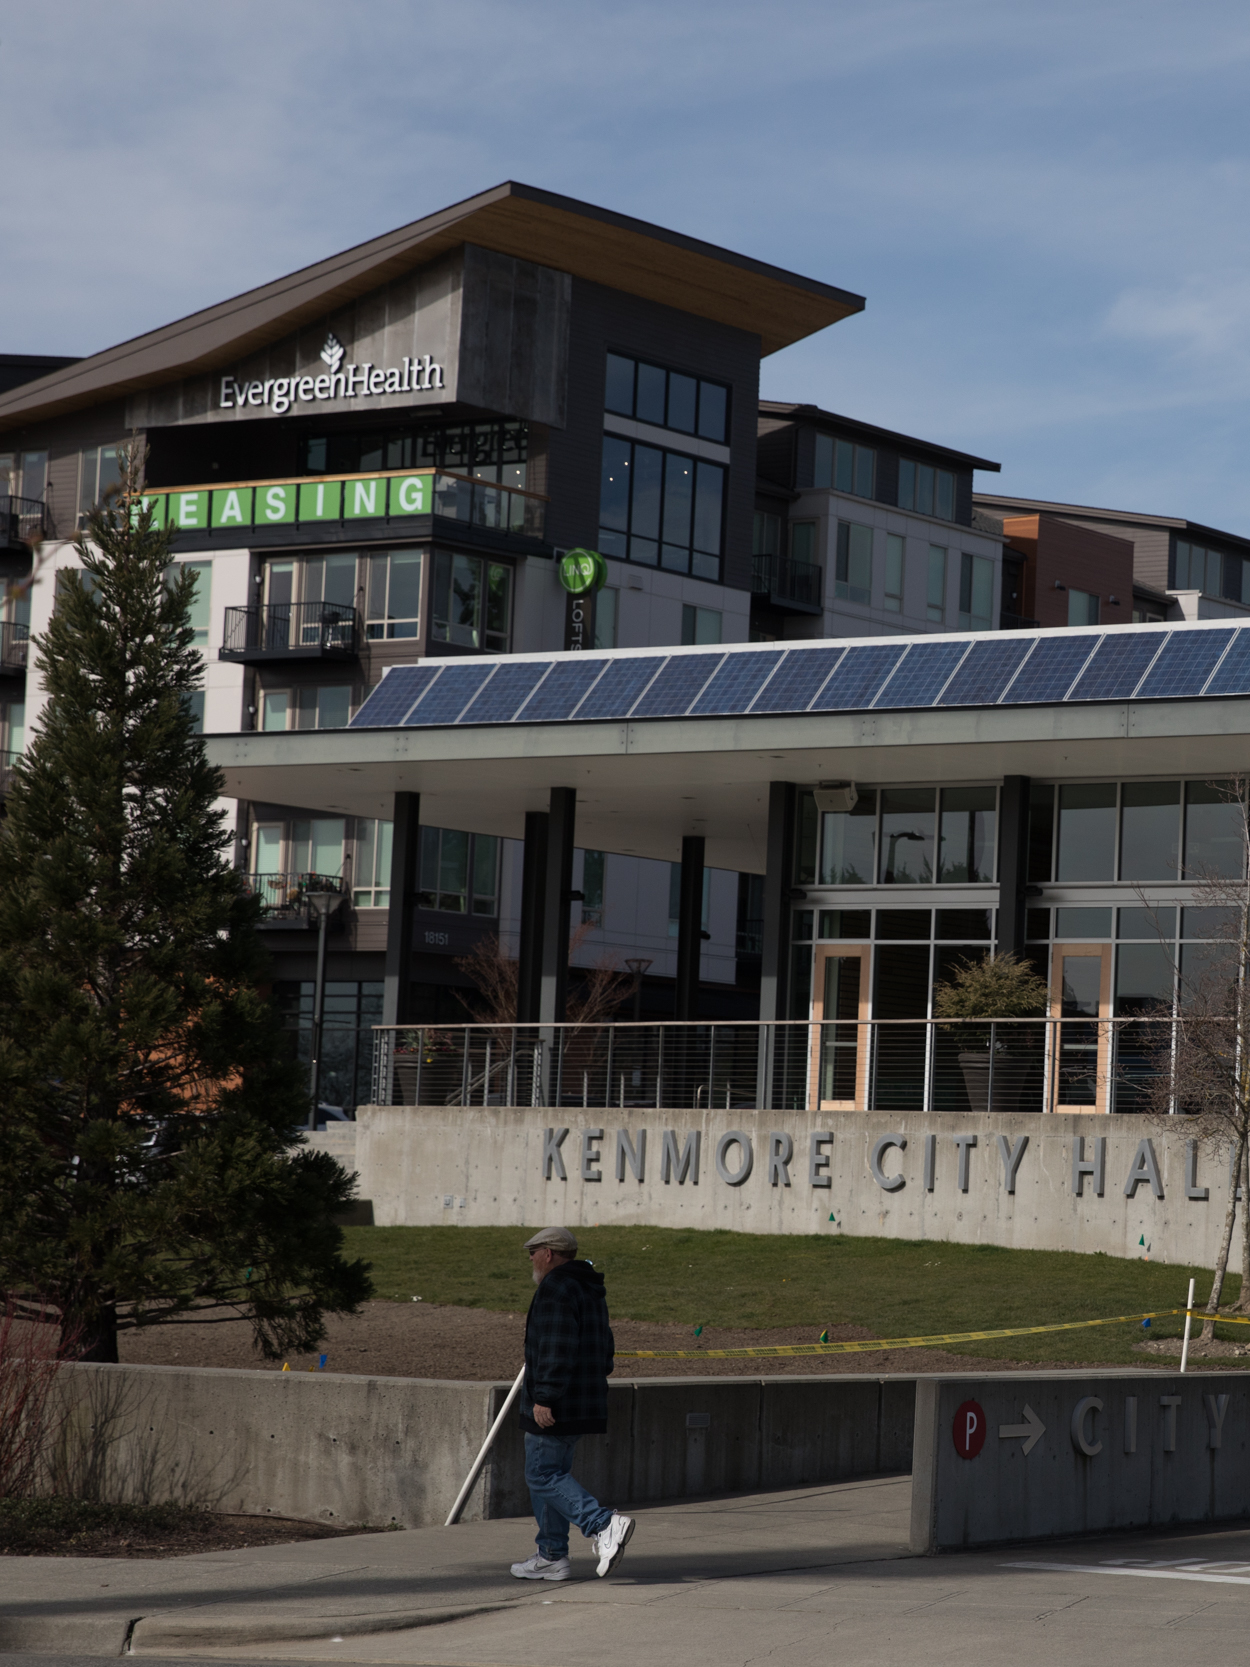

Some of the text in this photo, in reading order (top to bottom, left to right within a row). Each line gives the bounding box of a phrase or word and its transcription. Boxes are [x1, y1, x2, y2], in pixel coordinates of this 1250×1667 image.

[220, 355, 443, 414] EvergreenHealth
[563, 563, 590, 576] LINQ
[571, 600, 584, 651] LOFTS
[424, 931, 449, 945] 18151
[542, 1127, 834, 1189] KENMORE
[870, 1133, 1029, 1195] CITY
[1070, 1394, 1229, 1457] CITY
